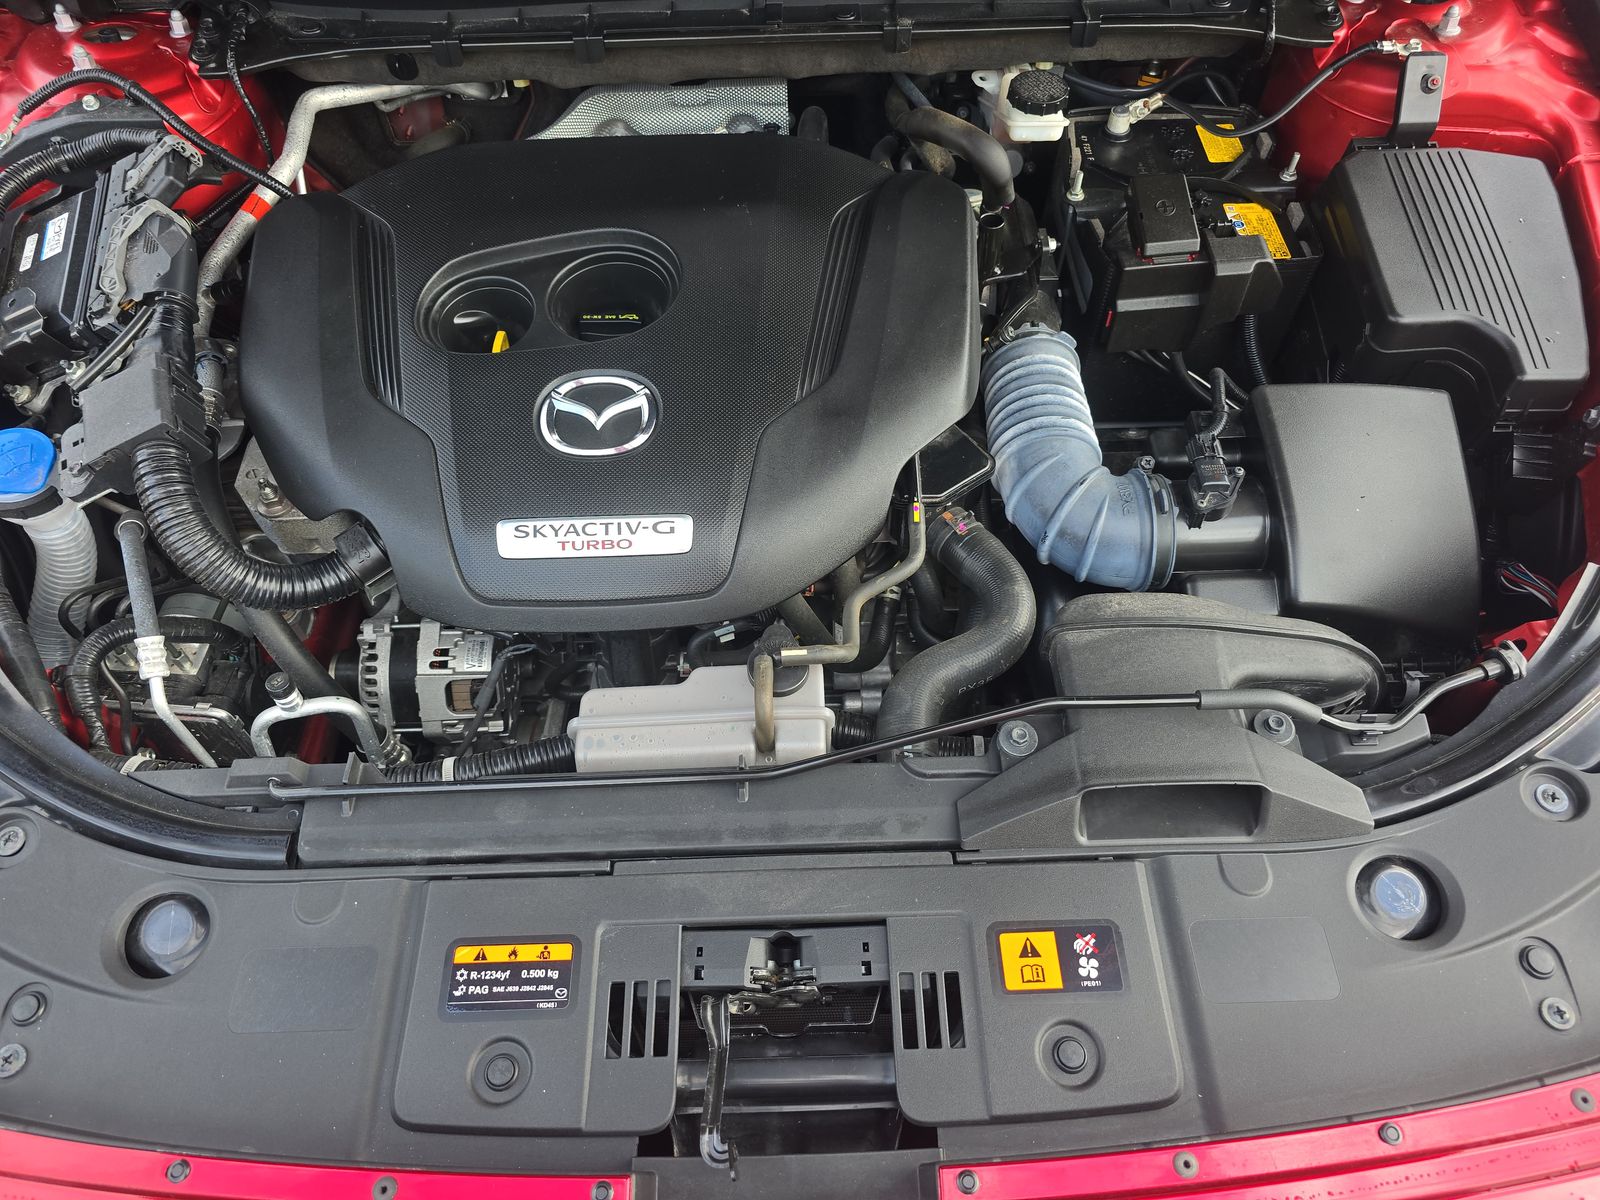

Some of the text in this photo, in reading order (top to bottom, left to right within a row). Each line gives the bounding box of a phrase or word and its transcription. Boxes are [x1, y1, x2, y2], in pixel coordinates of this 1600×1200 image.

[513, 519, 676, 539] SKYACTIV-G
[556, 538, 633, 552] TURBO
[470, 969, 559, 981] R-1234yf 0.500 kg
[468, 985, 489, 995] PAG
